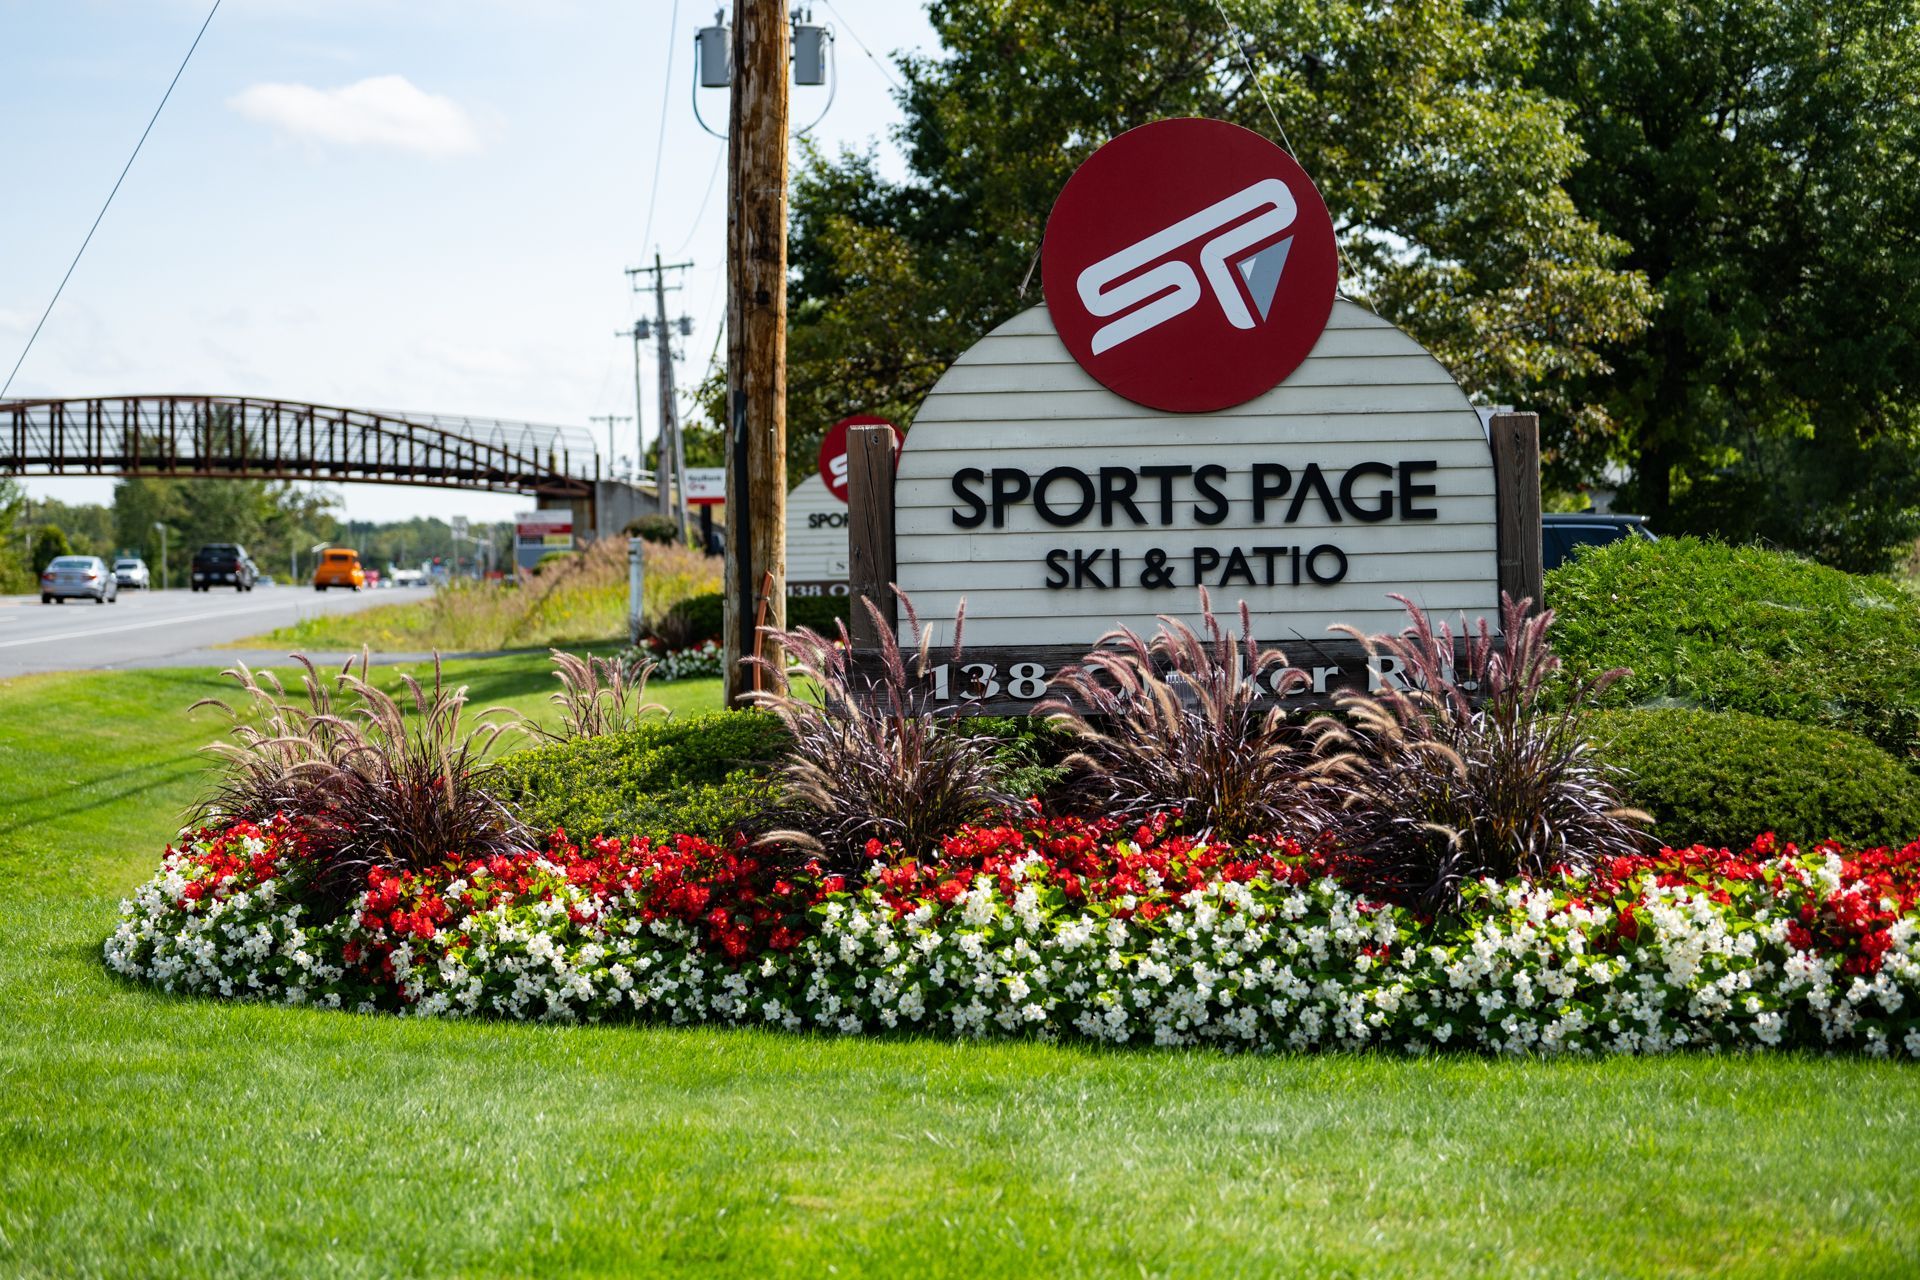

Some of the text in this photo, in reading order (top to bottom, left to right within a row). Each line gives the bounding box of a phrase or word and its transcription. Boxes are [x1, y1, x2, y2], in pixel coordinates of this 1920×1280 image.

[951, 460, 1438, 528] SPORTS PAGE
[1045, 544, 1348, 590] SKI & PATIO
[925, 662, 1047, 700] 138
